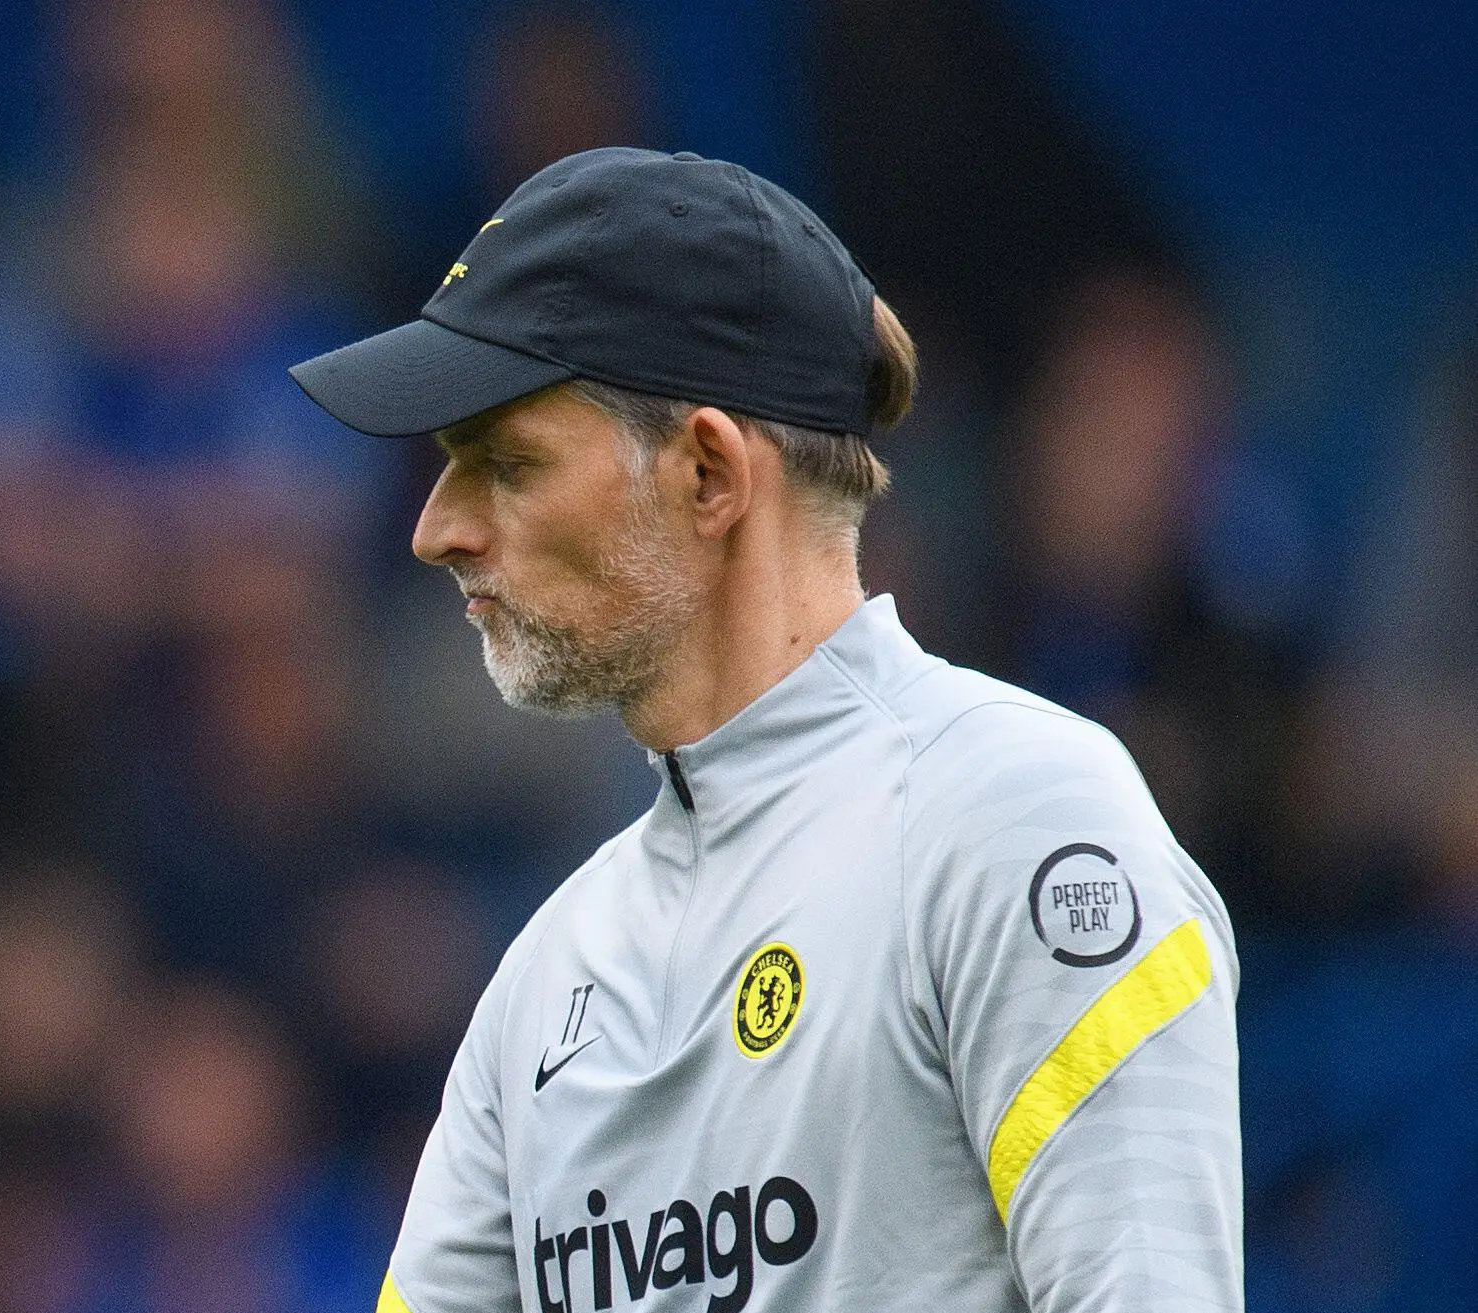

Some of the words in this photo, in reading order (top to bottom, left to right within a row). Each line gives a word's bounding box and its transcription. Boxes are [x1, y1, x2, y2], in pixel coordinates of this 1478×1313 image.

[1052, 881, 1119, 909] PERFECT
[1070, 907, 1110, 933] PLAY
[751, 953, 795, 977] CHELSEA
